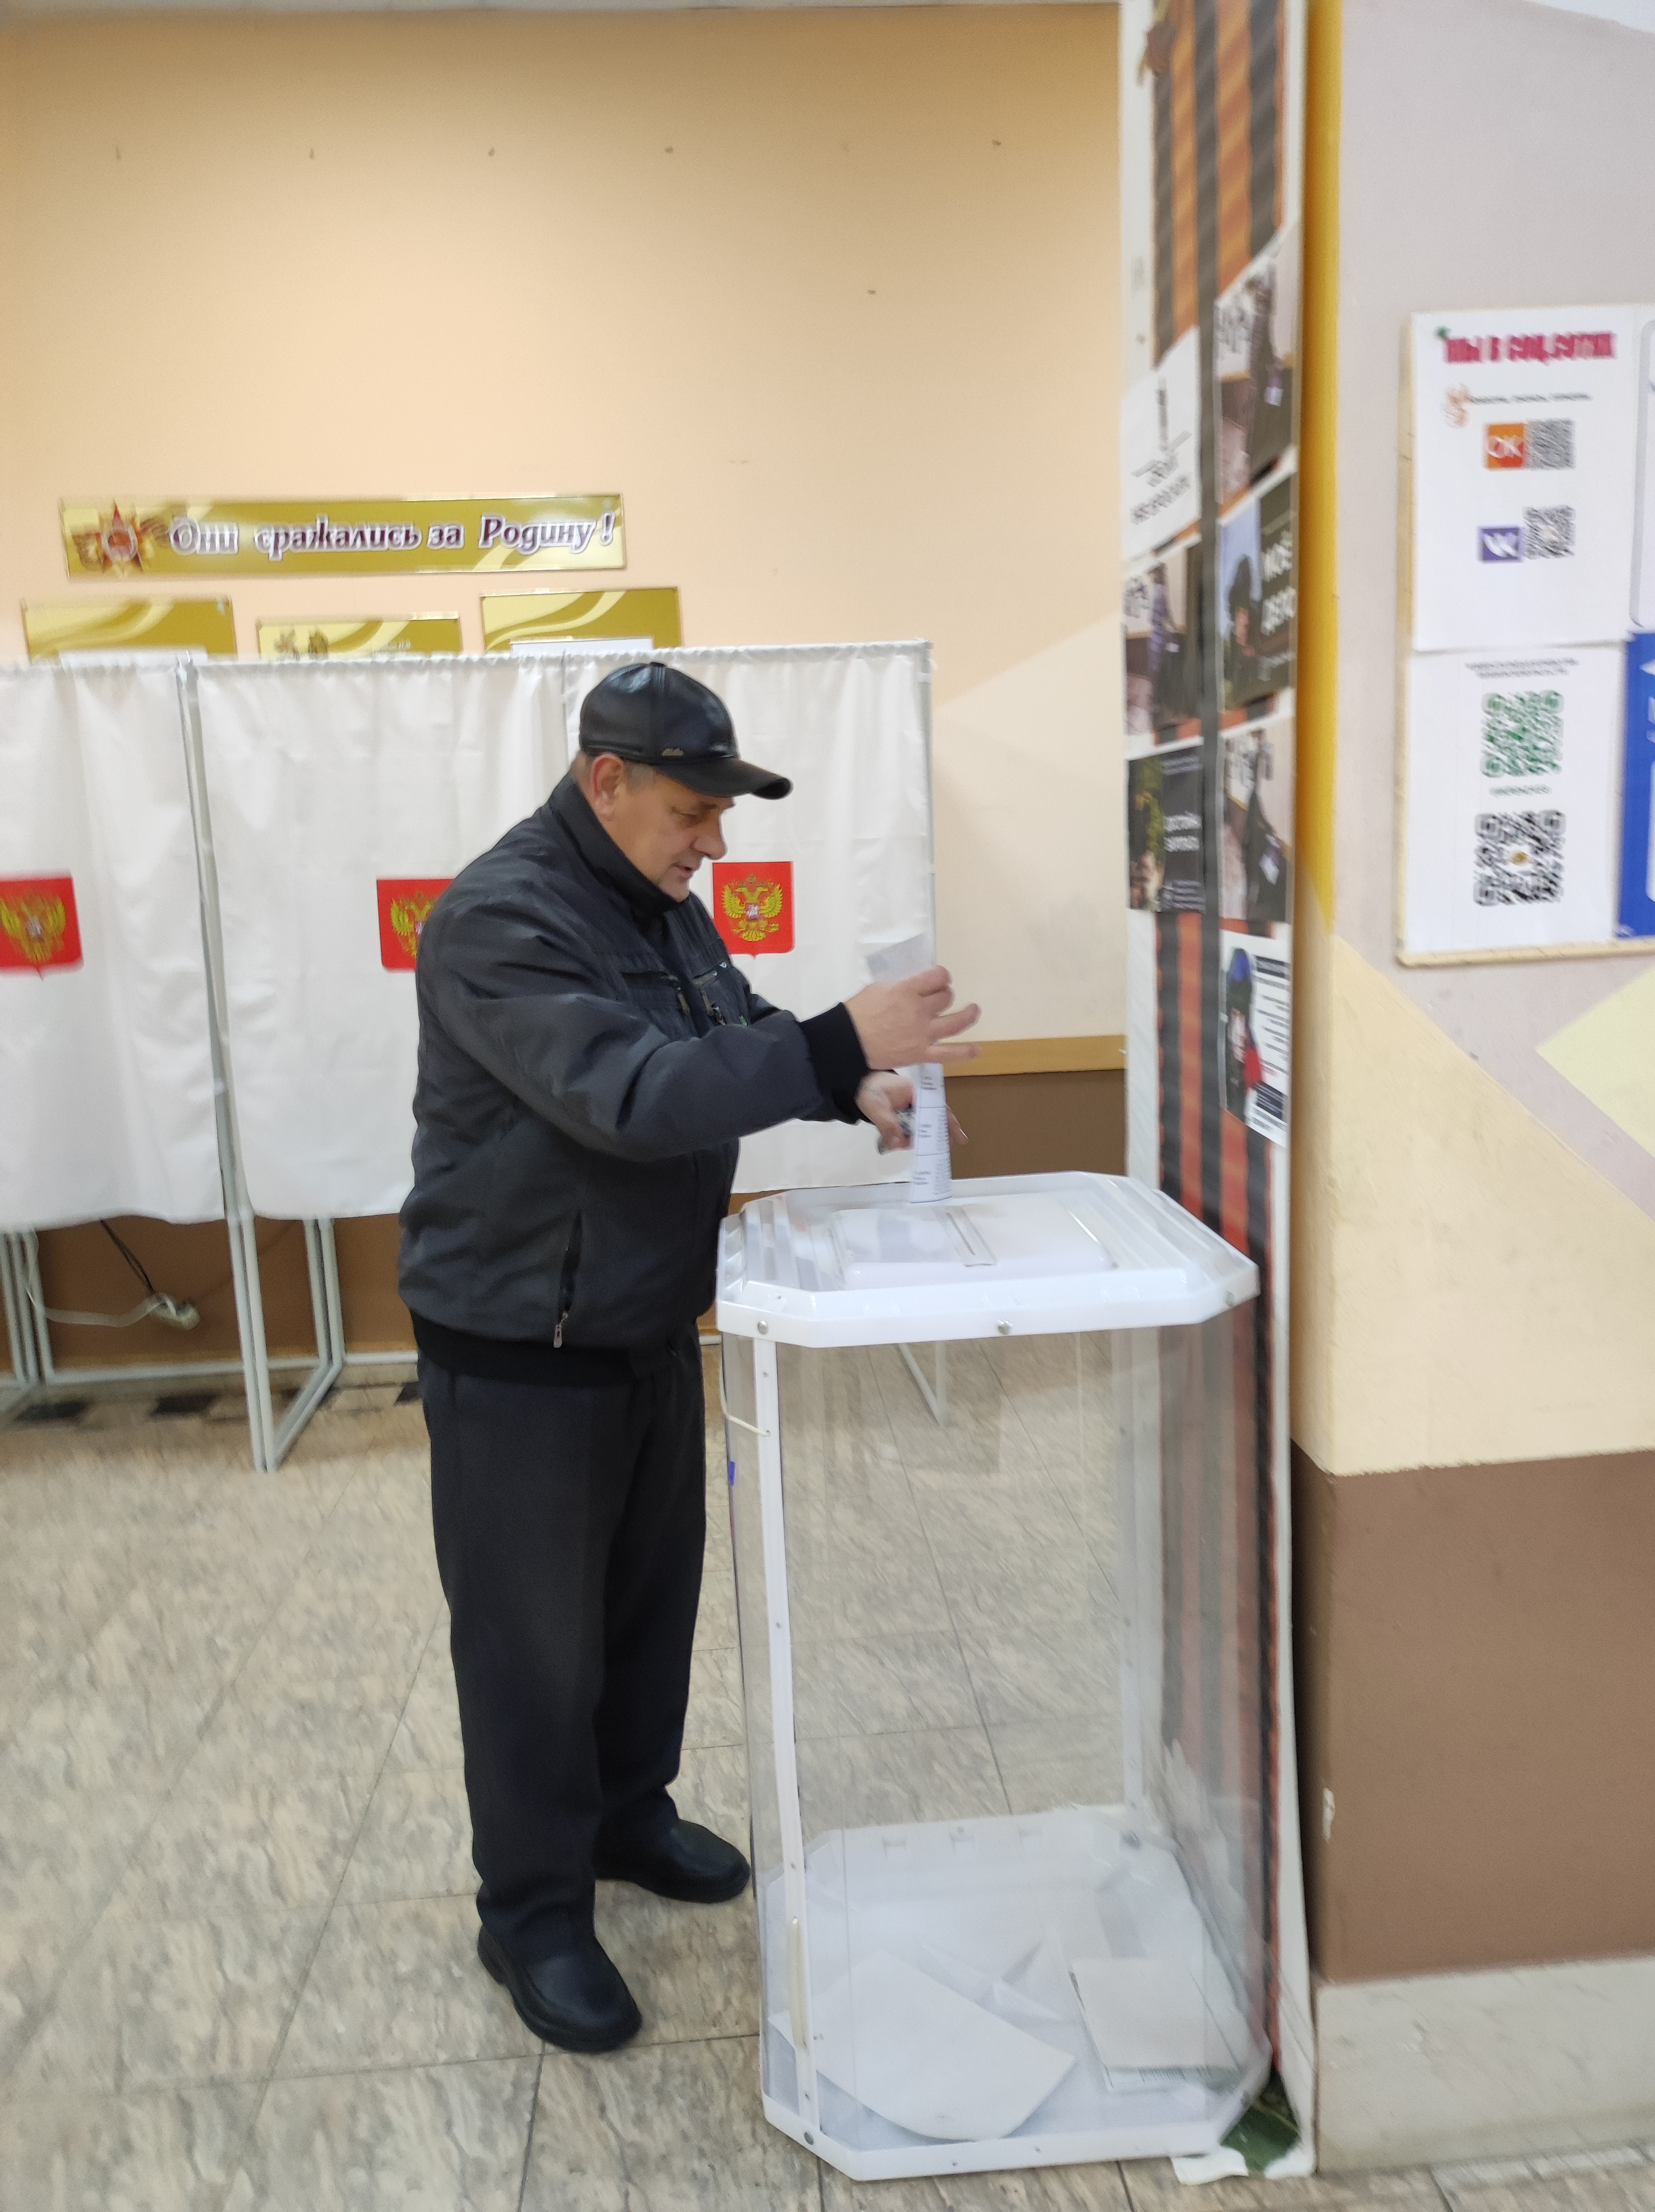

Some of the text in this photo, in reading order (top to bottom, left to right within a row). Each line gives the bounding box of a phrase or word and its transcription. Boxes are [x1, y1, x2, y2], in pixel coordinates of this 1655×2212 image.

[170, 516, 238, 556] Они
[254, 514, 423, 562] сражались
[427, 525, 465, 550] за
